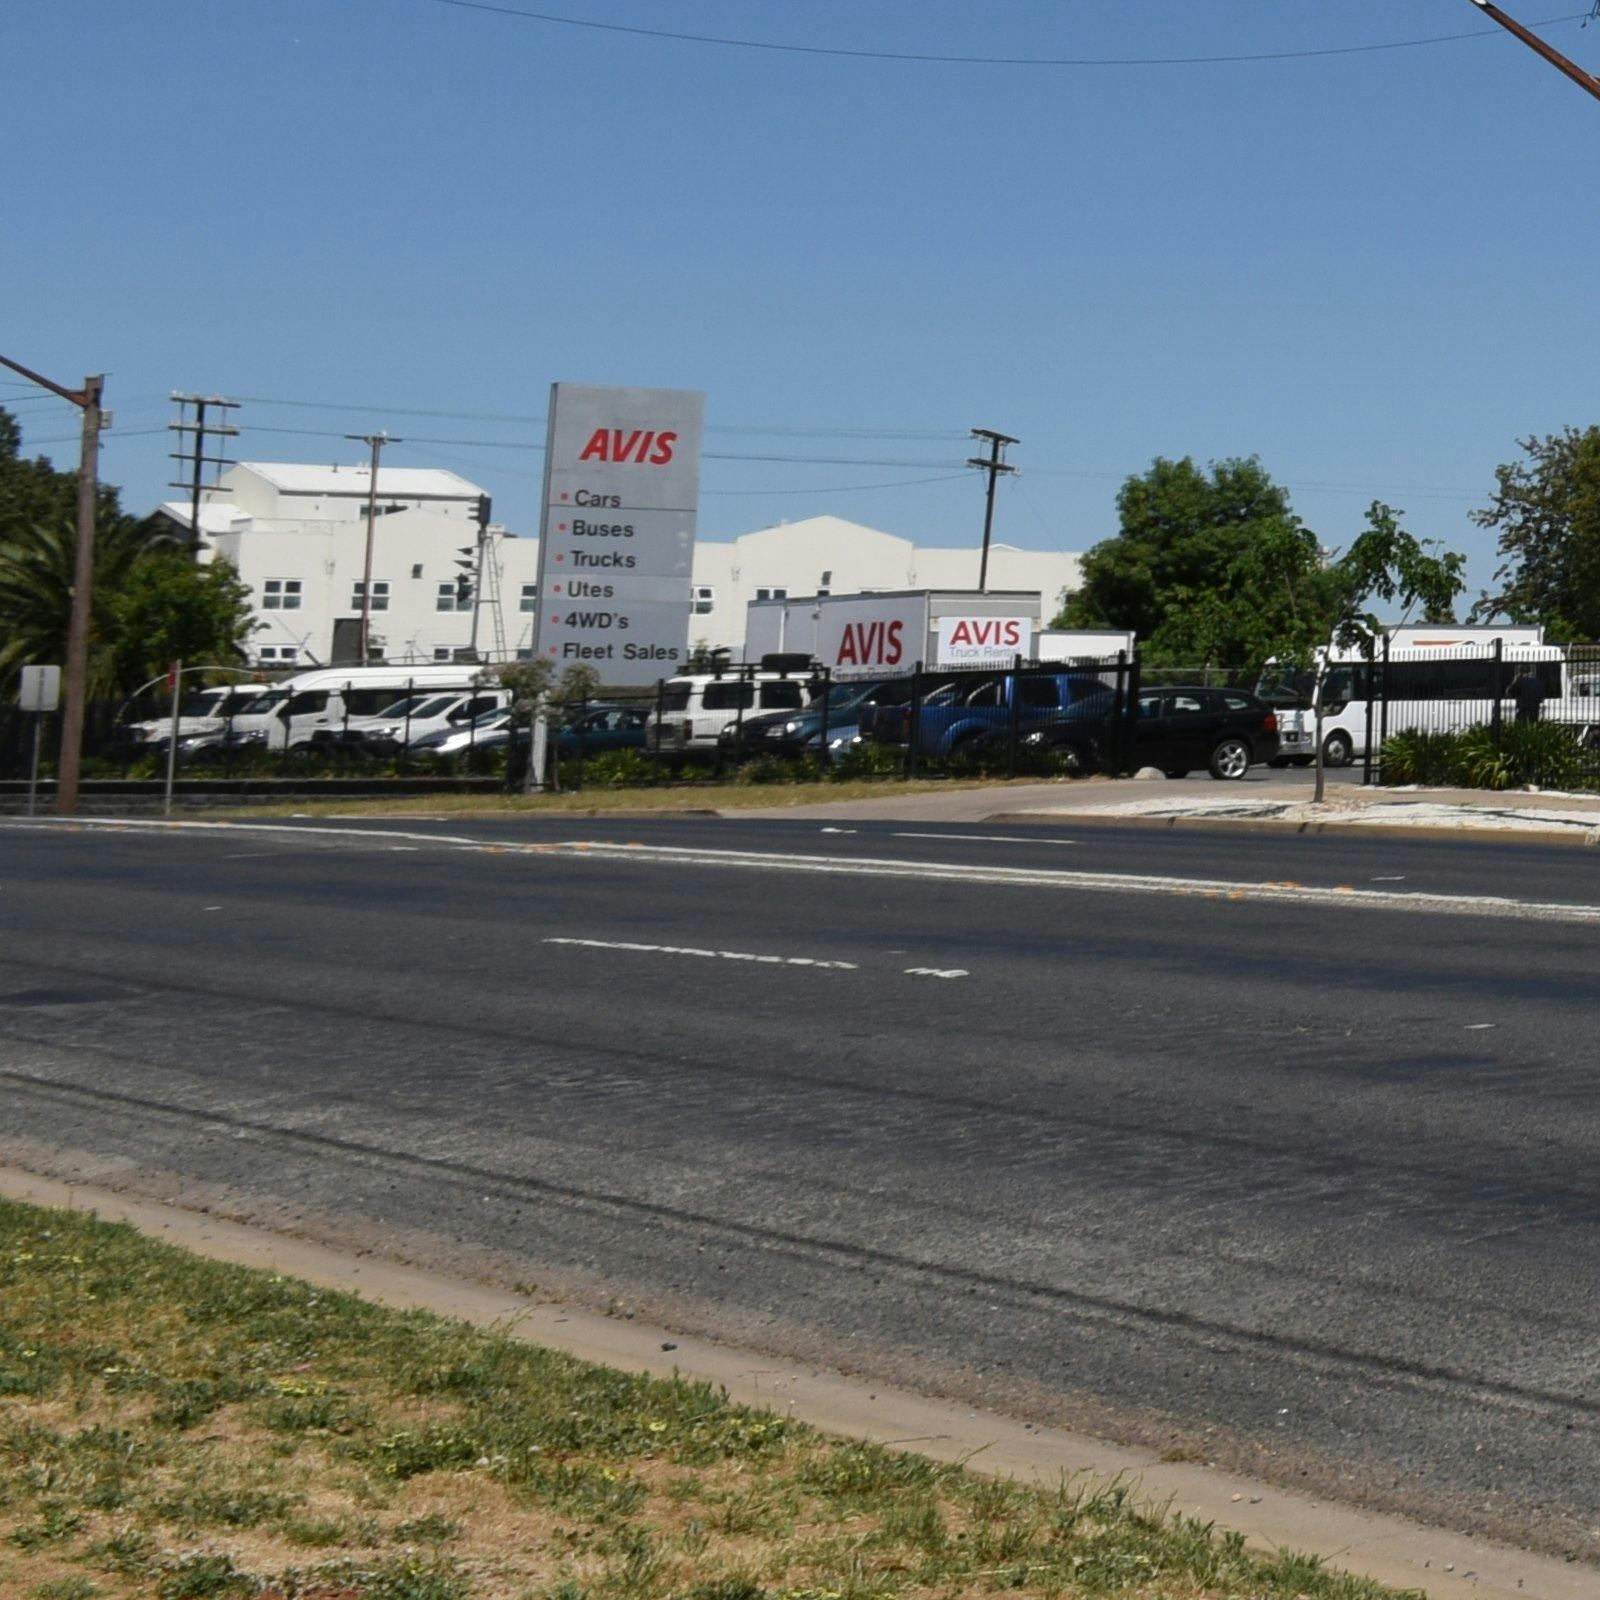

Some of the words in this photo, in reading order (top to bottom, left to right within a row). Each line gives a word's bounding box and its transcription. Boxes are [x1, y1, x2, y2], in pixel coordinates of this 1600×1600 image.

[579, 428, 678, 465] AVIS
[574, 489, 621, 507] Cars
[573, 520, 634, 537] Buses
[571, 551, 636, 568] Trucks
[568, 581, 614, 597] Utes
[565, 612, 629, 629] 4WD's
[949, 620, 1020, 646] AVIS
[563, 642, 613, 659] Fleet
[623, 643, 678, 660] Sales
[836, 620, 903, 666] AVIS
